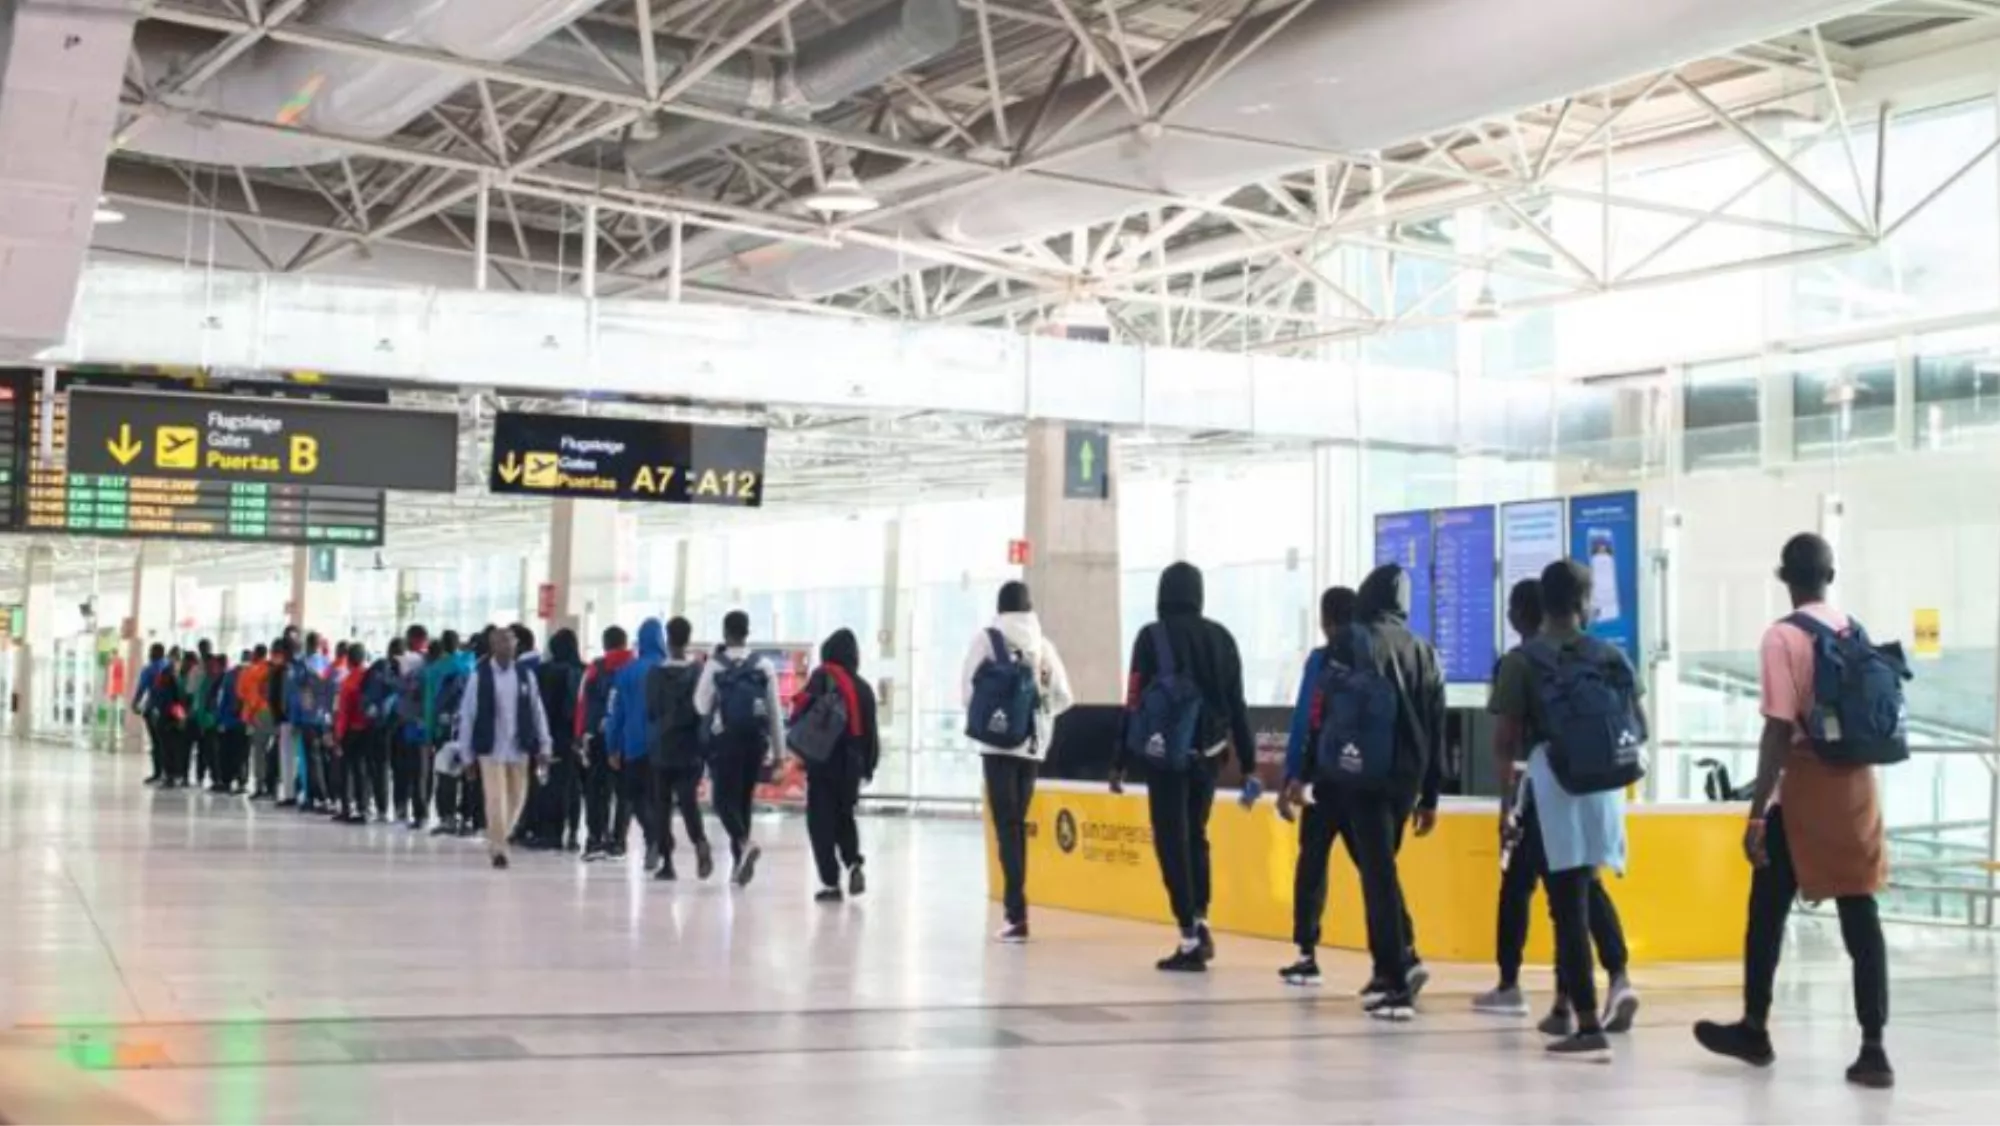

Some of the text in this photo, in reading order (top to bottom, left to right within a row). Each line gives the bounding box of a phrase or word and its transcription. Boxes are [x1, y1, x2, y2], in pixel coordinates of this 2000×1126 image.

[207, 410, 282, 433] Flugsteige
[207, 431, 251, 449] Gates
[206, 450, 280, 471] Puertas
[289, 435, 319, 474] B
[560, 456, 597, 471] Gates
[559, 473, 617, 491] Puertas
[631, 464, 676, 493] A7
